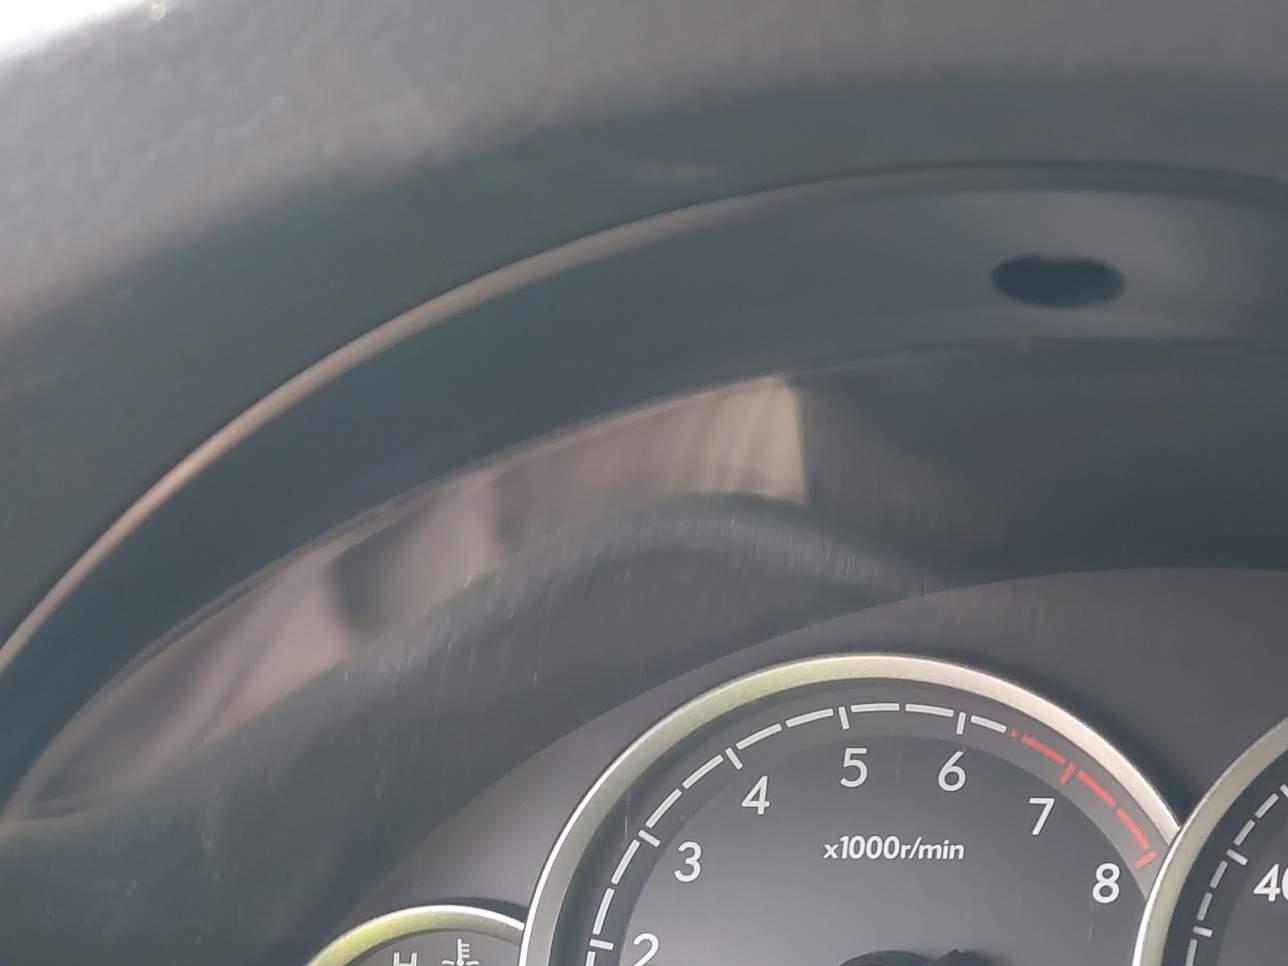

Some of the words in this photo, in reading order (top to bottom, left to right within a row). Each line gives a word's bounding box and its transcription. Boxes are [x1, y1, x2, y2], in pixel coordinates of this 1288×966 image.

[840, 748, 867, 787] 5
[939, 751, 965, 791] 6
[742, 776, 769, 814] 4
[1030, 798, 1054, 835] 7
[675, 842, 701, 881] 3
[824, 836, 964, 859] x1000r/min
[1093, 863, 1119, 903] 8
